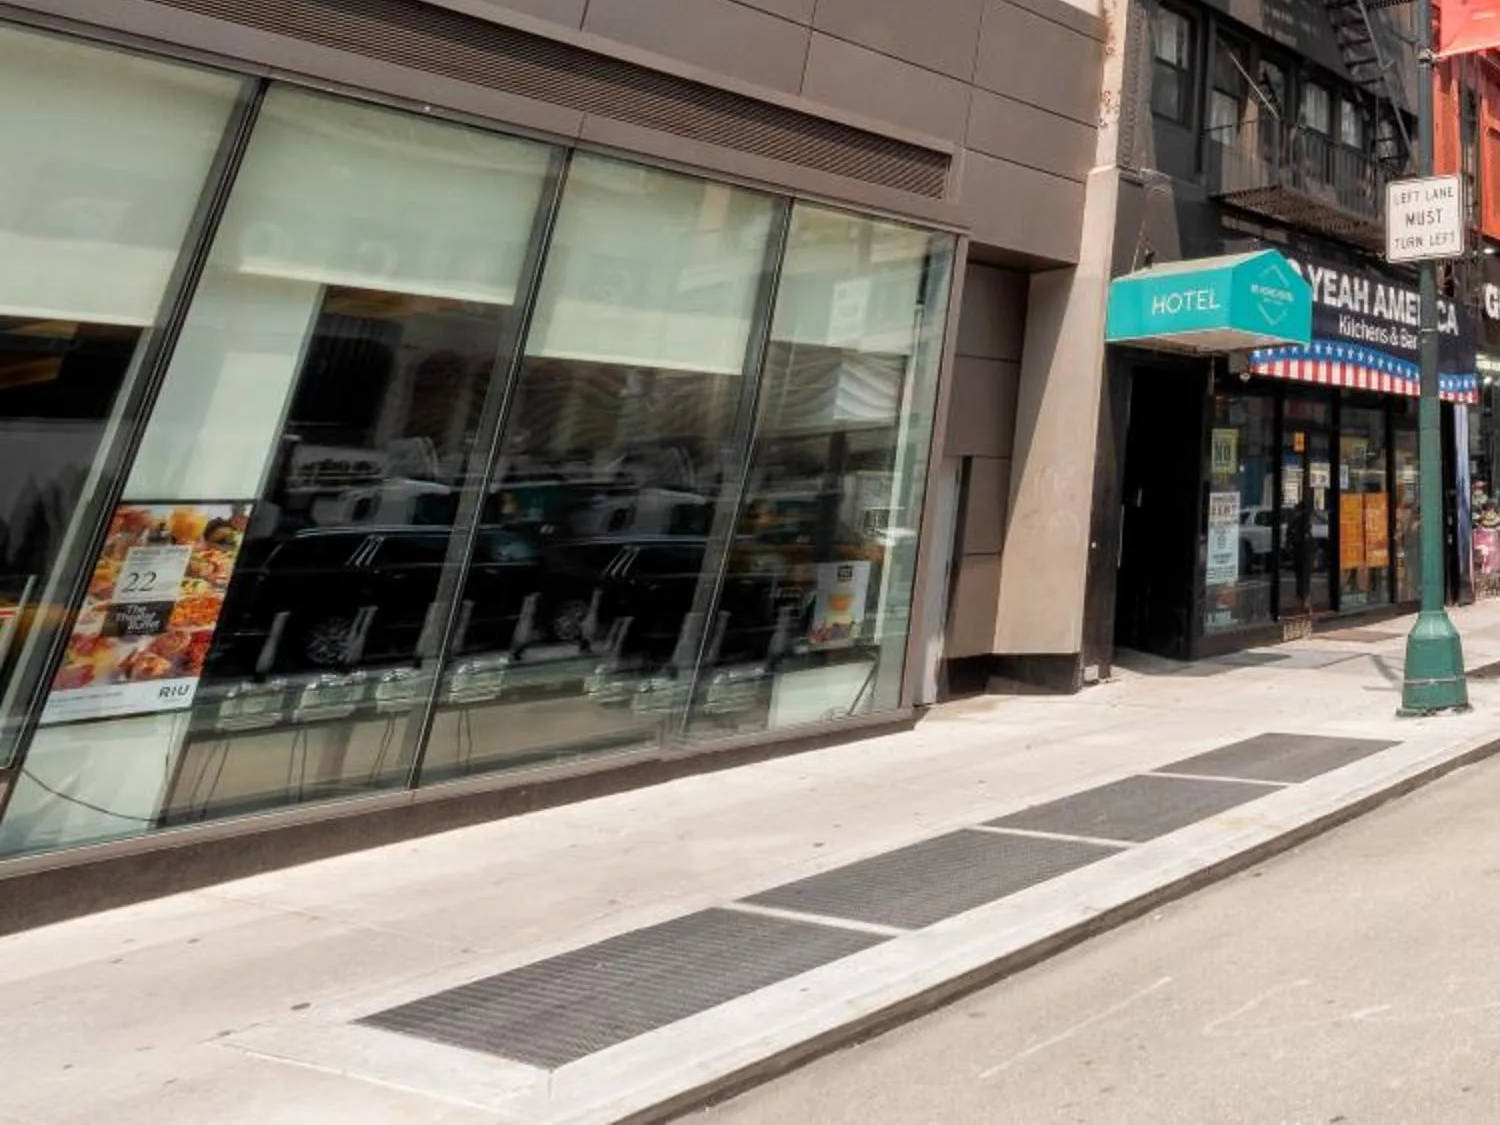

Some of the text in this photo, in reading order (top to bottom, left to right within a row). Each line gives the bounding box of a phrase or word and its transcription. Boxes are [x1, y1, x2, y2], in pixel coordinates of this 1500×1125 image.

[1394, 186, 1454, 206] LEFT LANE
[1405, 208, 1442, 227] MUST
[1395, 231, 1455, 250] TURN LEFT
[1151, 288, 1222, 316] HOTEL
[1307, 264, 1459, 337] YEAH AMECA
[1389, 327, 1399, 346] &
[121, 571, 157, 593] 22
[158, 684, 190, 699] RIU
